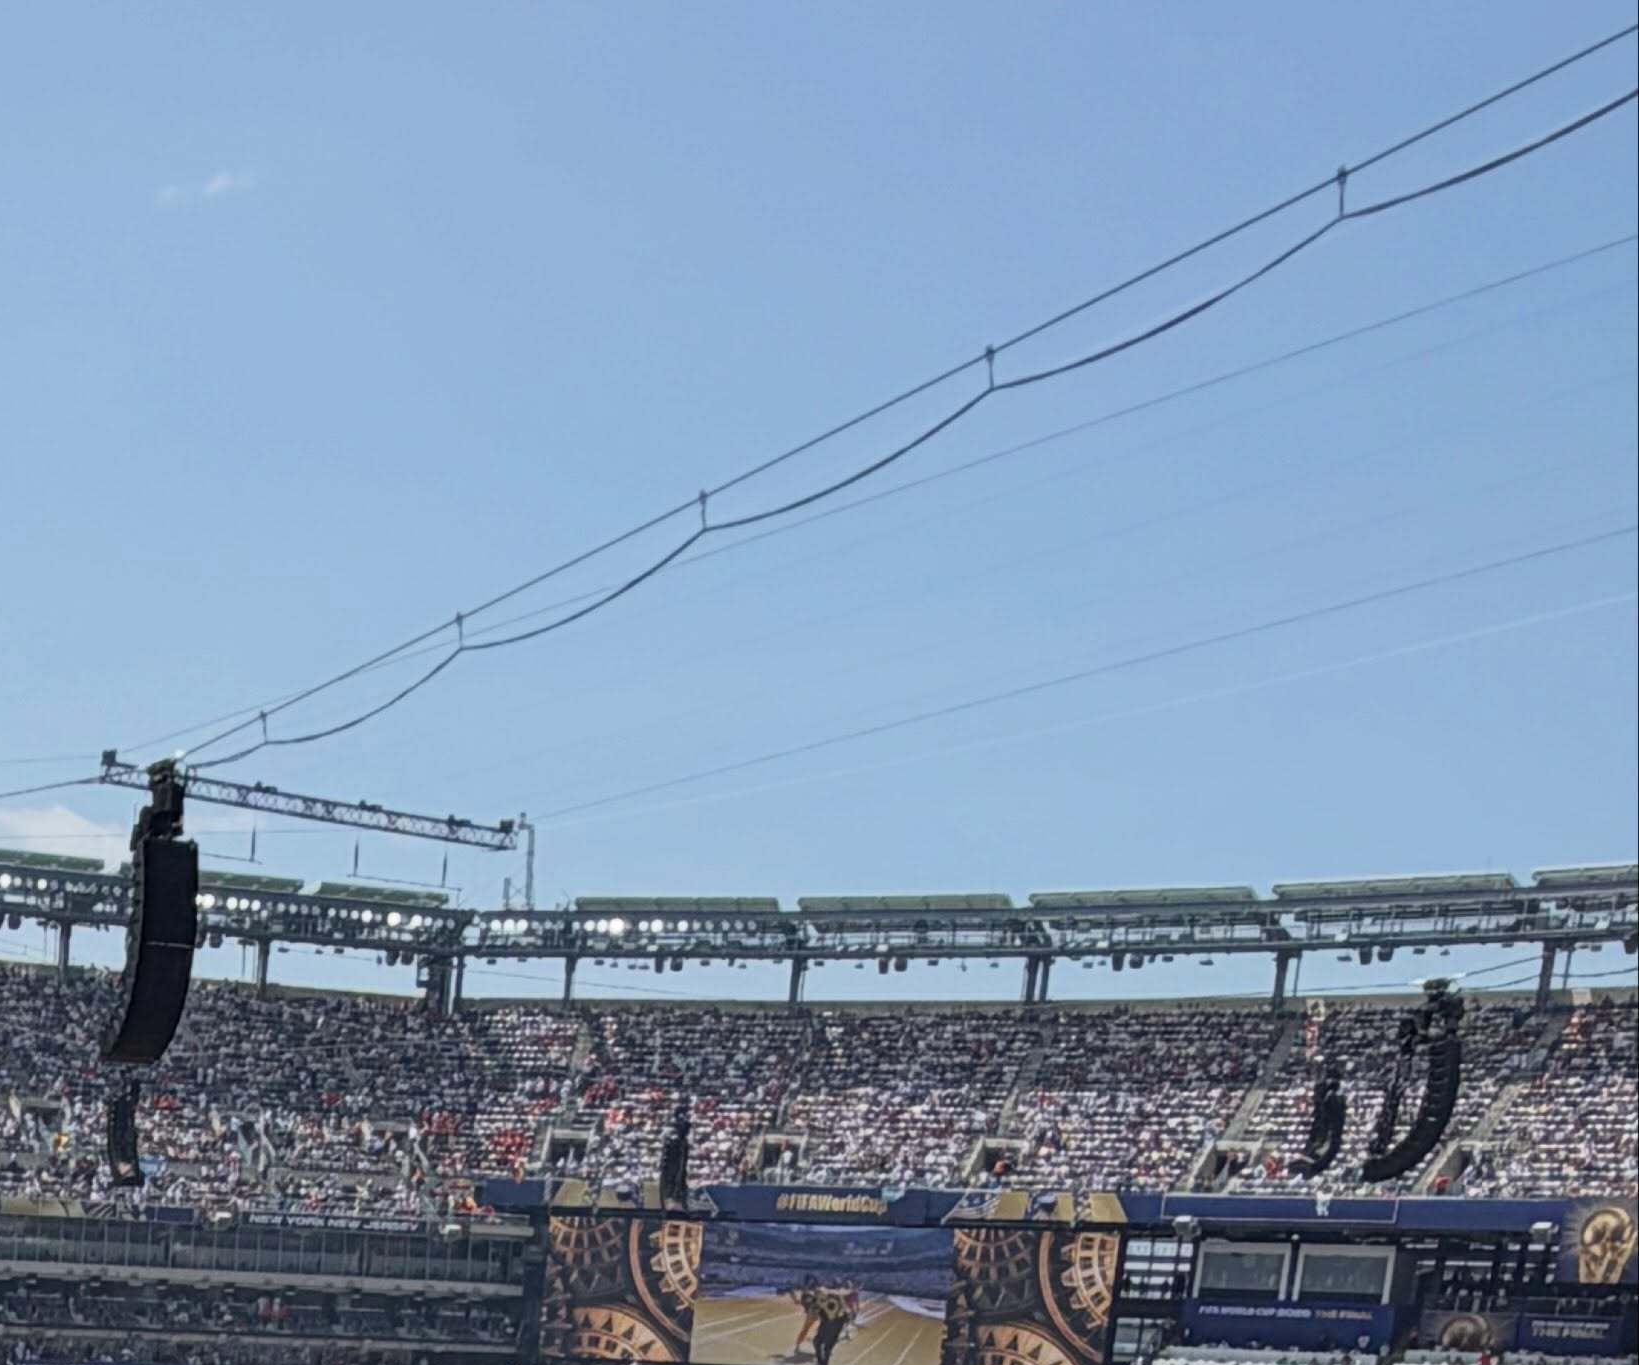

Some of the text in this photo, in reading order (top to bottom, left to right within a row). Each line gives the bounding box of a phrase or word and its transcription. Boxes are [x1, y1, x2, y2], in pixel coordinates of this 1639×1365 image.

[248, 1213, 419, 1232] NEW YORK NEW JERSEY
